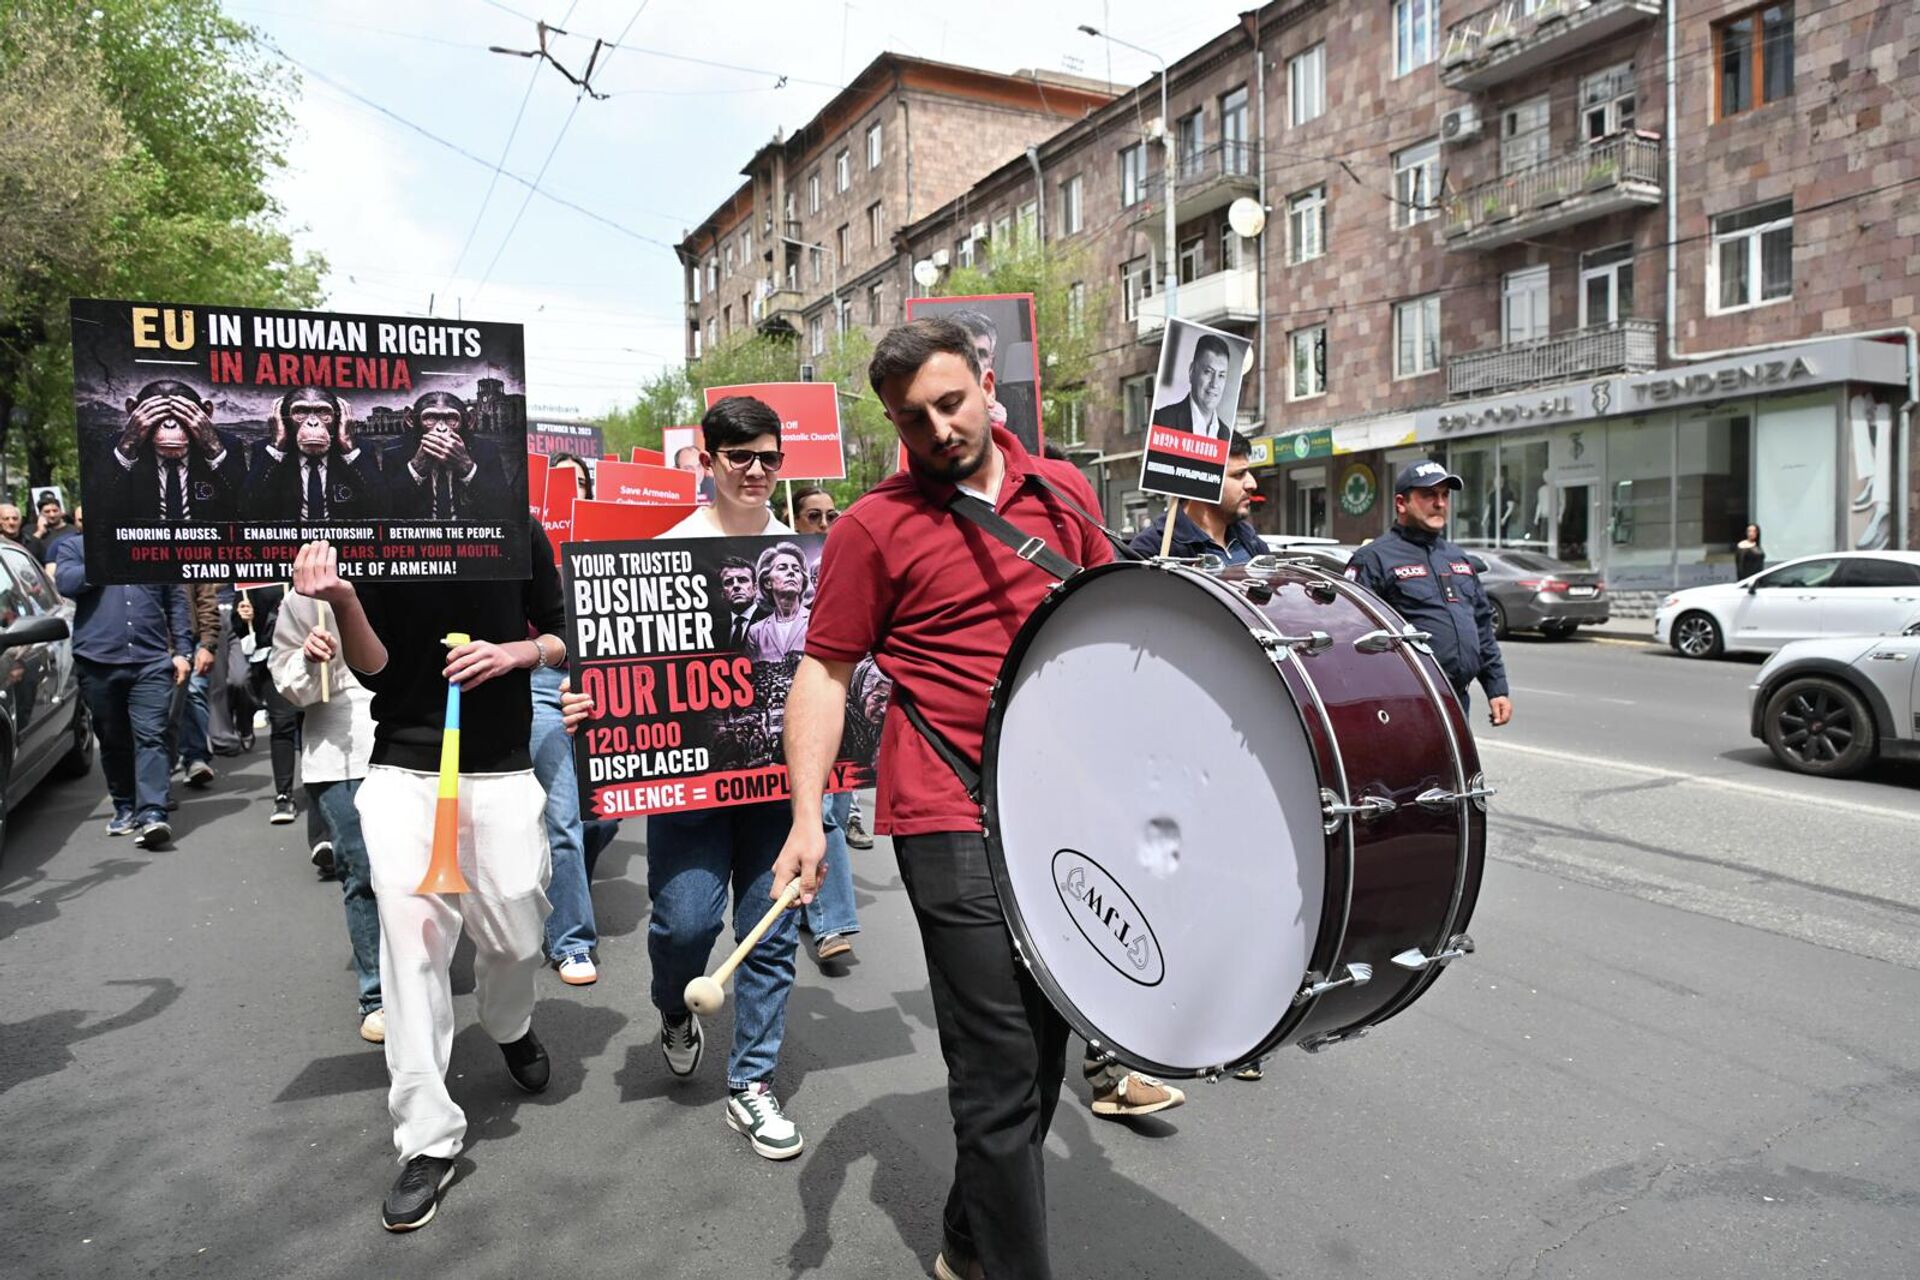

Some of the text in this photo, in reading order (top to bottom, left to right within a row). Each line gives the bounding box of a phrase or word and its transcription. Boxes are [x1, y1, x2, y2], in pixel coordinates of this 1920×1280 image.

[132, 307, 481, 358] EU IN HUMAN RIGHTS
[210, 350, 413, 391] IN ARMENIA
[1630, 356, 1818, 403] TENDENZA
[528, 433, 598, 457] GENOCIDE
[537, 423, 568, 434] SEPTEMBER
[781, 433, 809, 442] postolic
[620, 485, 680, 500] Save Armenian
[116, 527, 505, 541] IGNORING ABUSES. ENABLING DICTATORSHIP. BETRAYING THE PEOPLE.
[131, 545, 502, 561] OPEN YOUR EYES. OPEN EARS. OPEN YOUR MOUTH.
[182, 561, 457, 579] STAND WITH TH PLE OF ARMENIA!
[571, 551, 693, 578] YOUR TRUSTED
[574, 574, 709, 616] BUSINESS
[576, 612, 715, 658] PARTNER
[581, 657, 755, 720] OUR LOSS
[585, 721, 681, 756] 120,000
[589, 747, 709, 783] DISPLACED
[603, 784, 686, 814] SILENCE
[715, 765, 846, 802] COMPLY
[1082, 886, 1130, 948] TJW
